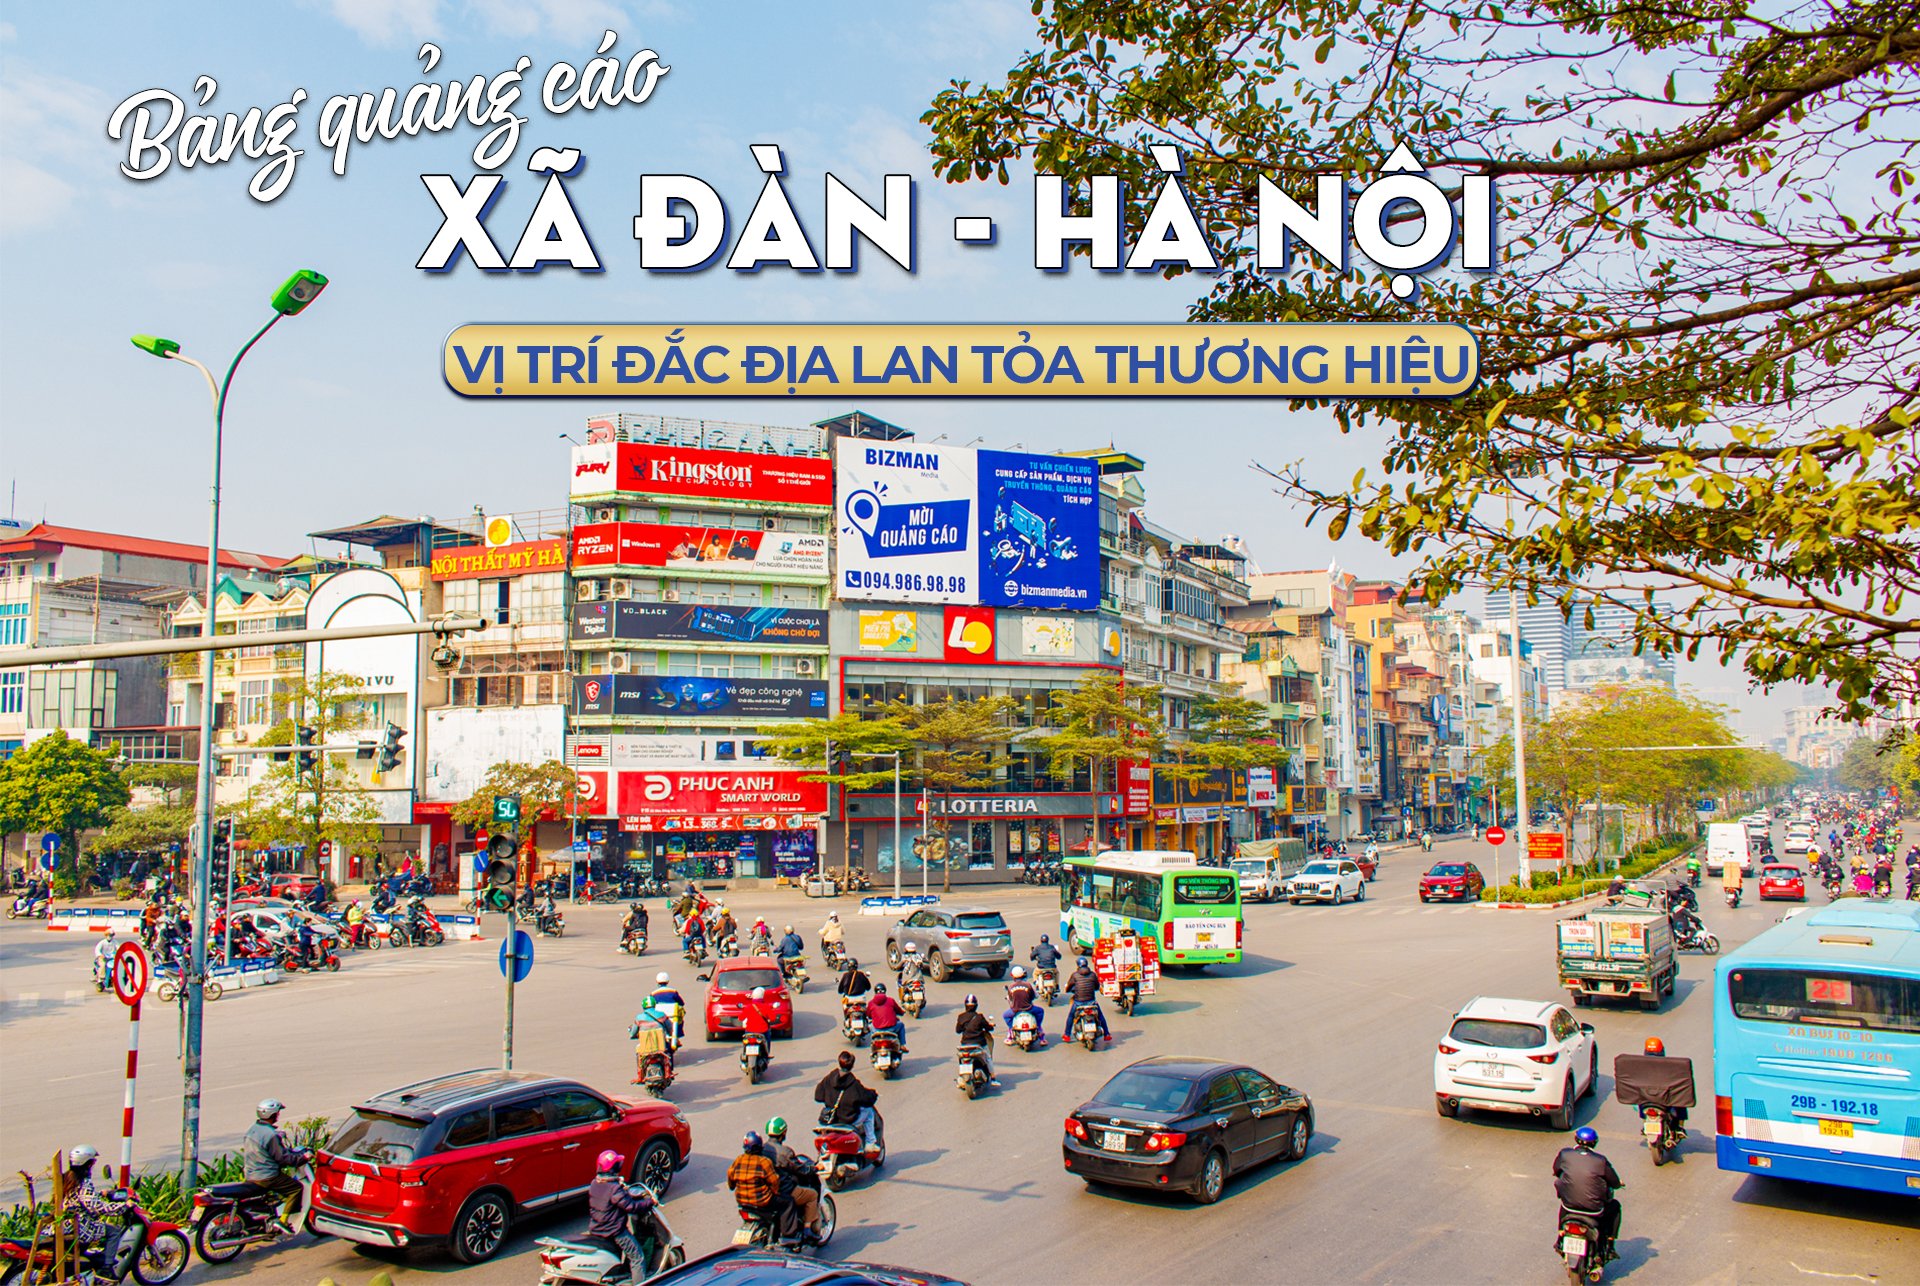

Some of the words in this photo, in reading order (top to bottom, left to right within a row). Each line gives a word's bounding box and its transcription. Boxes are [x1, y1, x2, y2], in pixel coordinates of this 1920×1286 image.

[865, 448, 939, 471] BIZMAN
[651, 456, 752, 485] Kingston
[995, 469, 1013, 478] CUNG
[1015, 469, 1028, 479] CẤP
[669, 477, 752, 488] TECHNOLOGY
[1063, 494, 1078, 503] TÍCH
[909, 506, 934, 526] MỜI
[880, 525, 926, 548] QUẢNG
[931, 525, 957, 545] CÁO
[798, 539, 824, 547] AMD
[577, 544, 614, 555] RYZEN
[431, 554, 458, 578] NỘI
[460, 547, 506, 572] THẤT
[509, 547, 536, 569] MỸ
[538, 543, 565, 567] HÀ
[864, 571, 966, 593] 094.986.98.98
[1021, 583, 1088, 599] bizmanmedia.vn
[579, 616, 606, 626] Western
[584, 625, 606, 635] Digital
[739, 686, 756, 697] đẹp
[758, 687, 779, 696] công
[781, 688, 803, 697] nghệ
[679, 777, 728, 791] PHUC
[732, 777, 774, 791] ANH
[721, 793, 758, 802] SMART
[761, 793, 801, 802] WORLD
[941, 799, 1038, 814] LOTTERIA
[1810, 1028, 1834, 1039] BUS
[1791, 1095, 1817, 1109] 29B
[1831, 1099, 1878, 1116] 192.18
